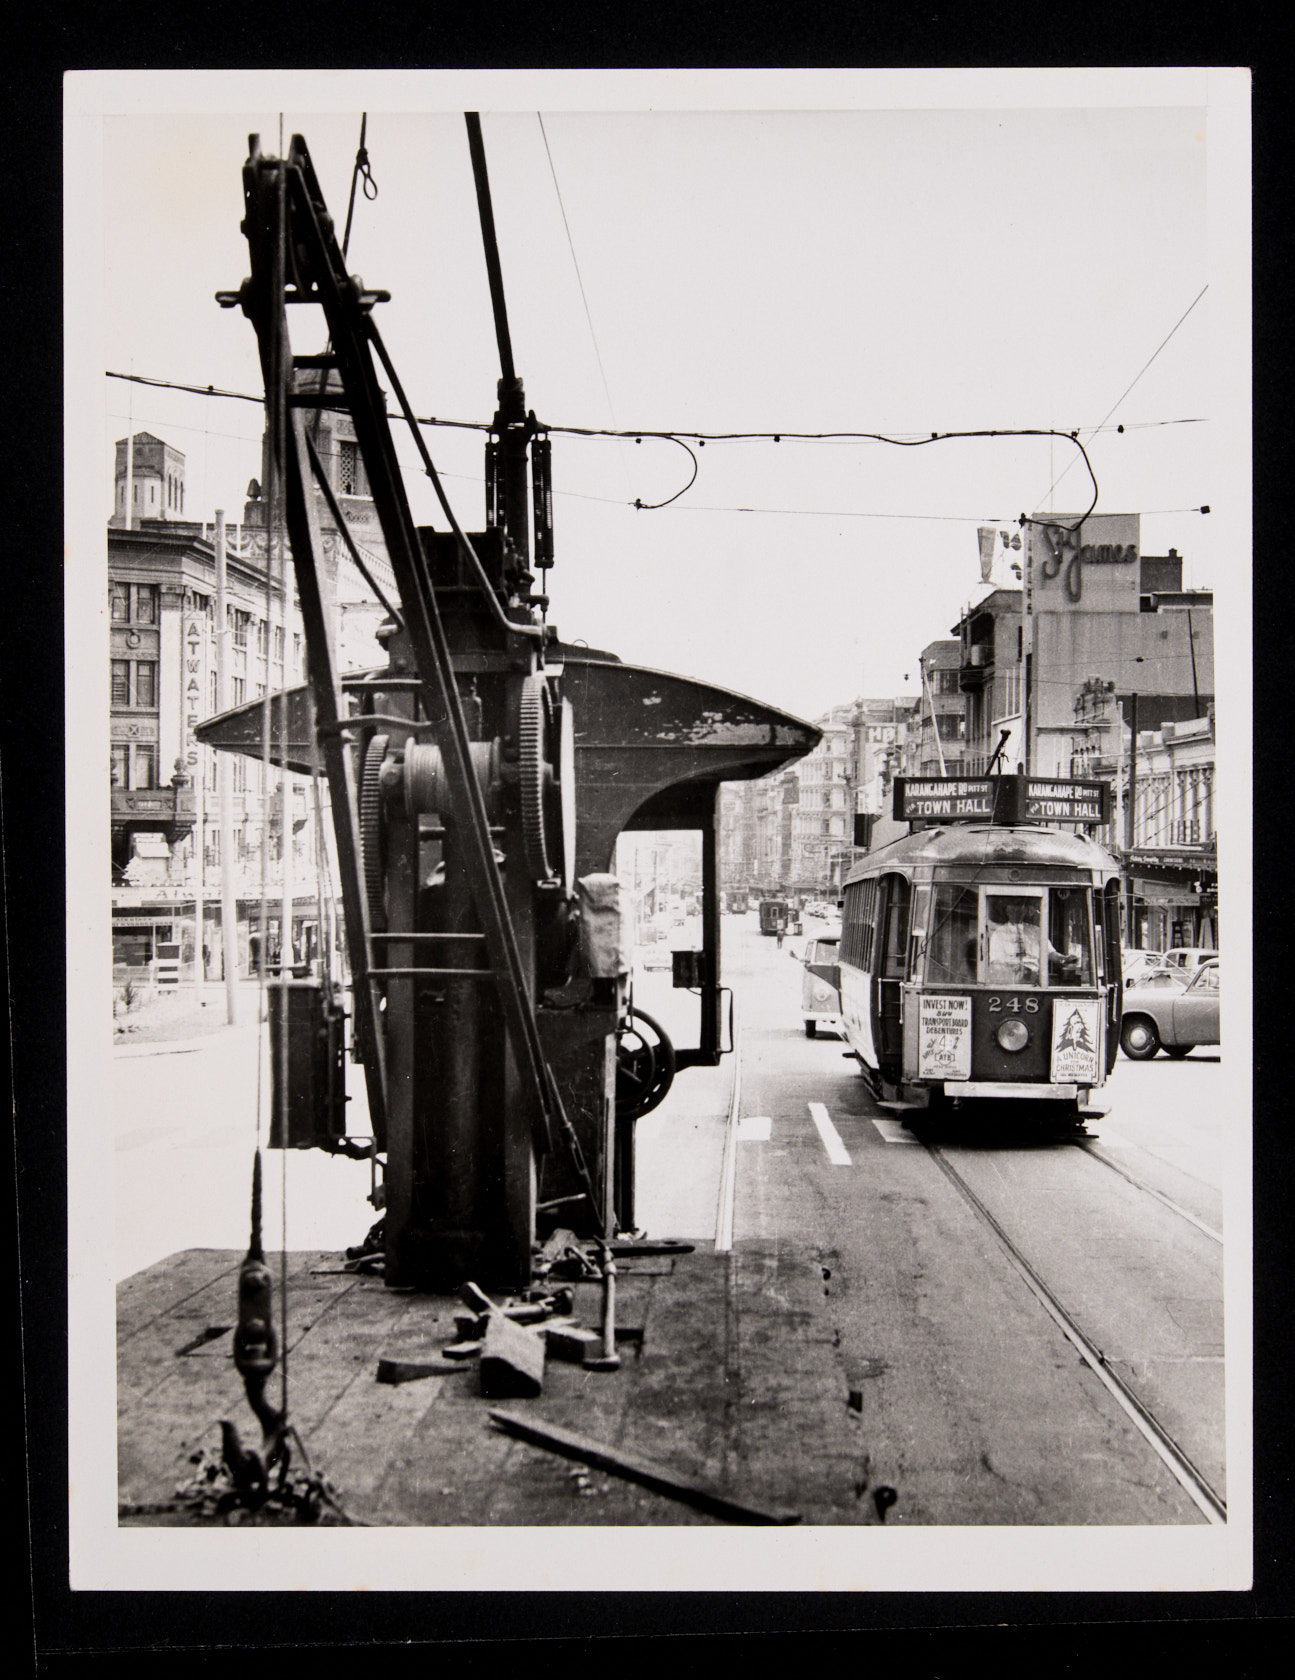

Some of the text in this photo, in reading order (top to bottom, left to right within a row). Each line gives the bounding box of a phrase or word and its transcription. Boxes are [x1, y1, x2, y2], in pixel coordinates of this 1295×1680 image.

[186, 622, 201, 766] ATWATERS
[905, 782, 957, 797] KARANGAHAPE
[1028, 784, 1074, 799] KARANGAHAPE
[917, 800, 951, 814] TOWN
[956, 799, 990, 813] HALL
[1040, 801, 1070, 816] TOWN
[1075, 803, 1101, 817] HALL
[923, 999, 968, 1011] INVEST NOW!
[988, 996, 1040, 1014] 248
[922, 1017, 969, 1028] TRANSPORT BOARD
[926, 1027, 963, 1035] DEBENTURES
[1063, 1051, 1094, 1064] UNICORN
[1056, 1063, 1093, 1072] CHRISTMAS
